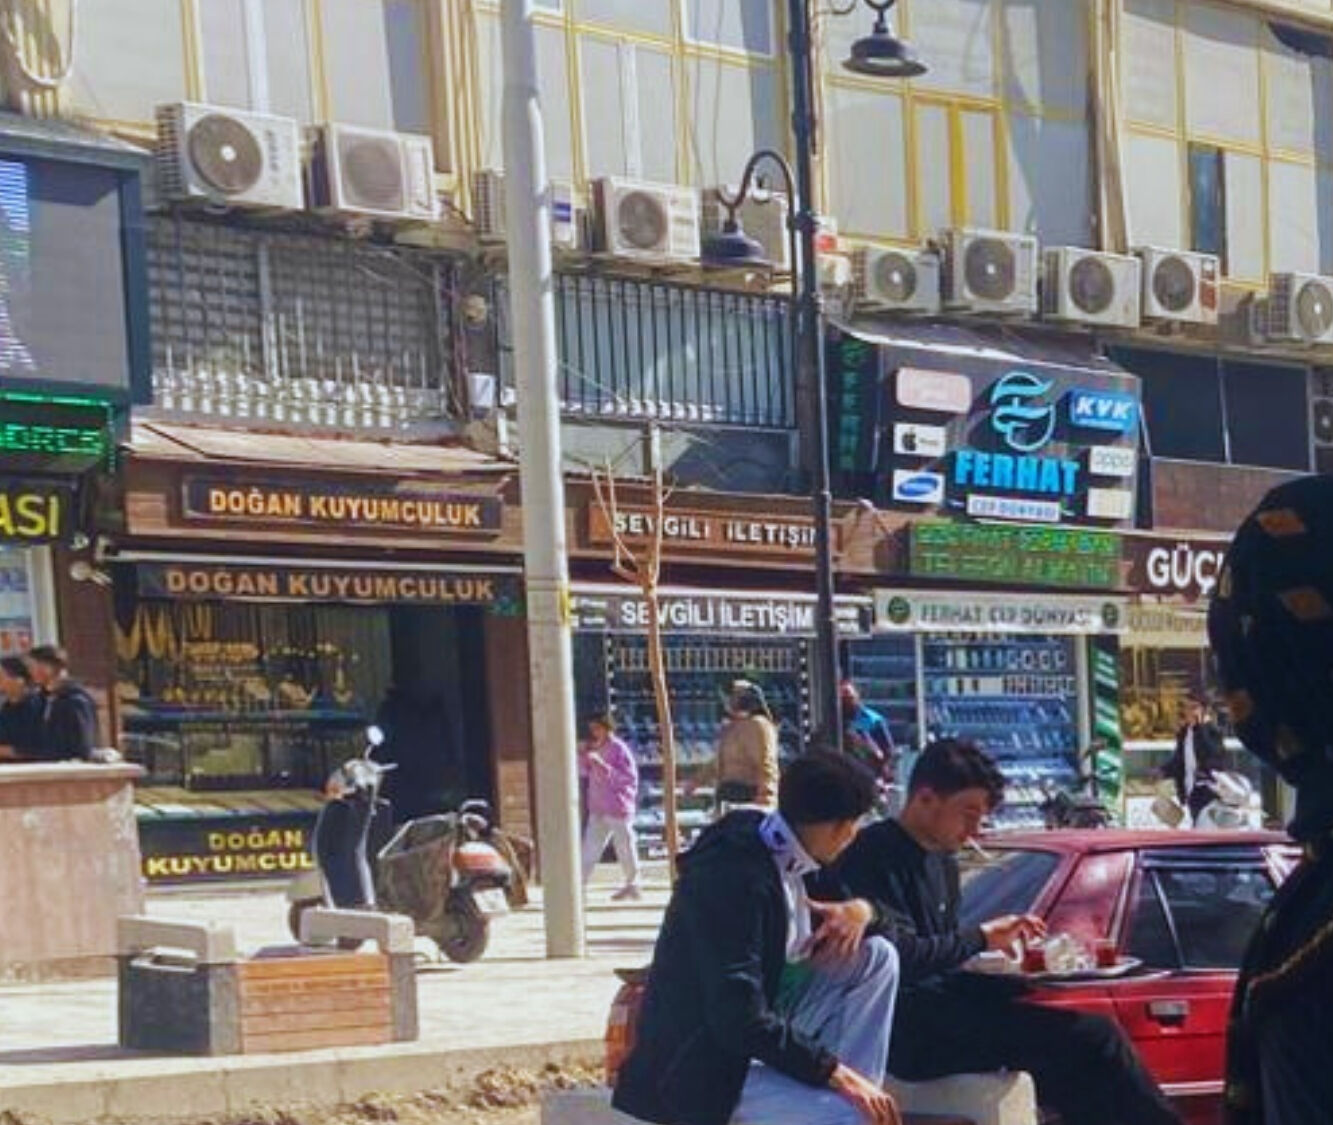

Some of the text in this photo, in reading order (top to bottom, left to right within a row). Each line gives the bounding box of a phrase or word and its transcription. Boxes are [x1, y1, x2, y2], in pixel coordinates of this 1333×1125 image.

[1076, 396, 1132, 420] KVK
[955, 449, 1080, 495] FERHAT
[209, 487, 481, 527] DOĞAN KUYUMCULUK
[288, 573, 495, 600] KUYUMCULUK
[621, 599, 816, 632] SEVGİLİ İLETİŞİM
[147, 852, 316, 876] KUYUMCUL
